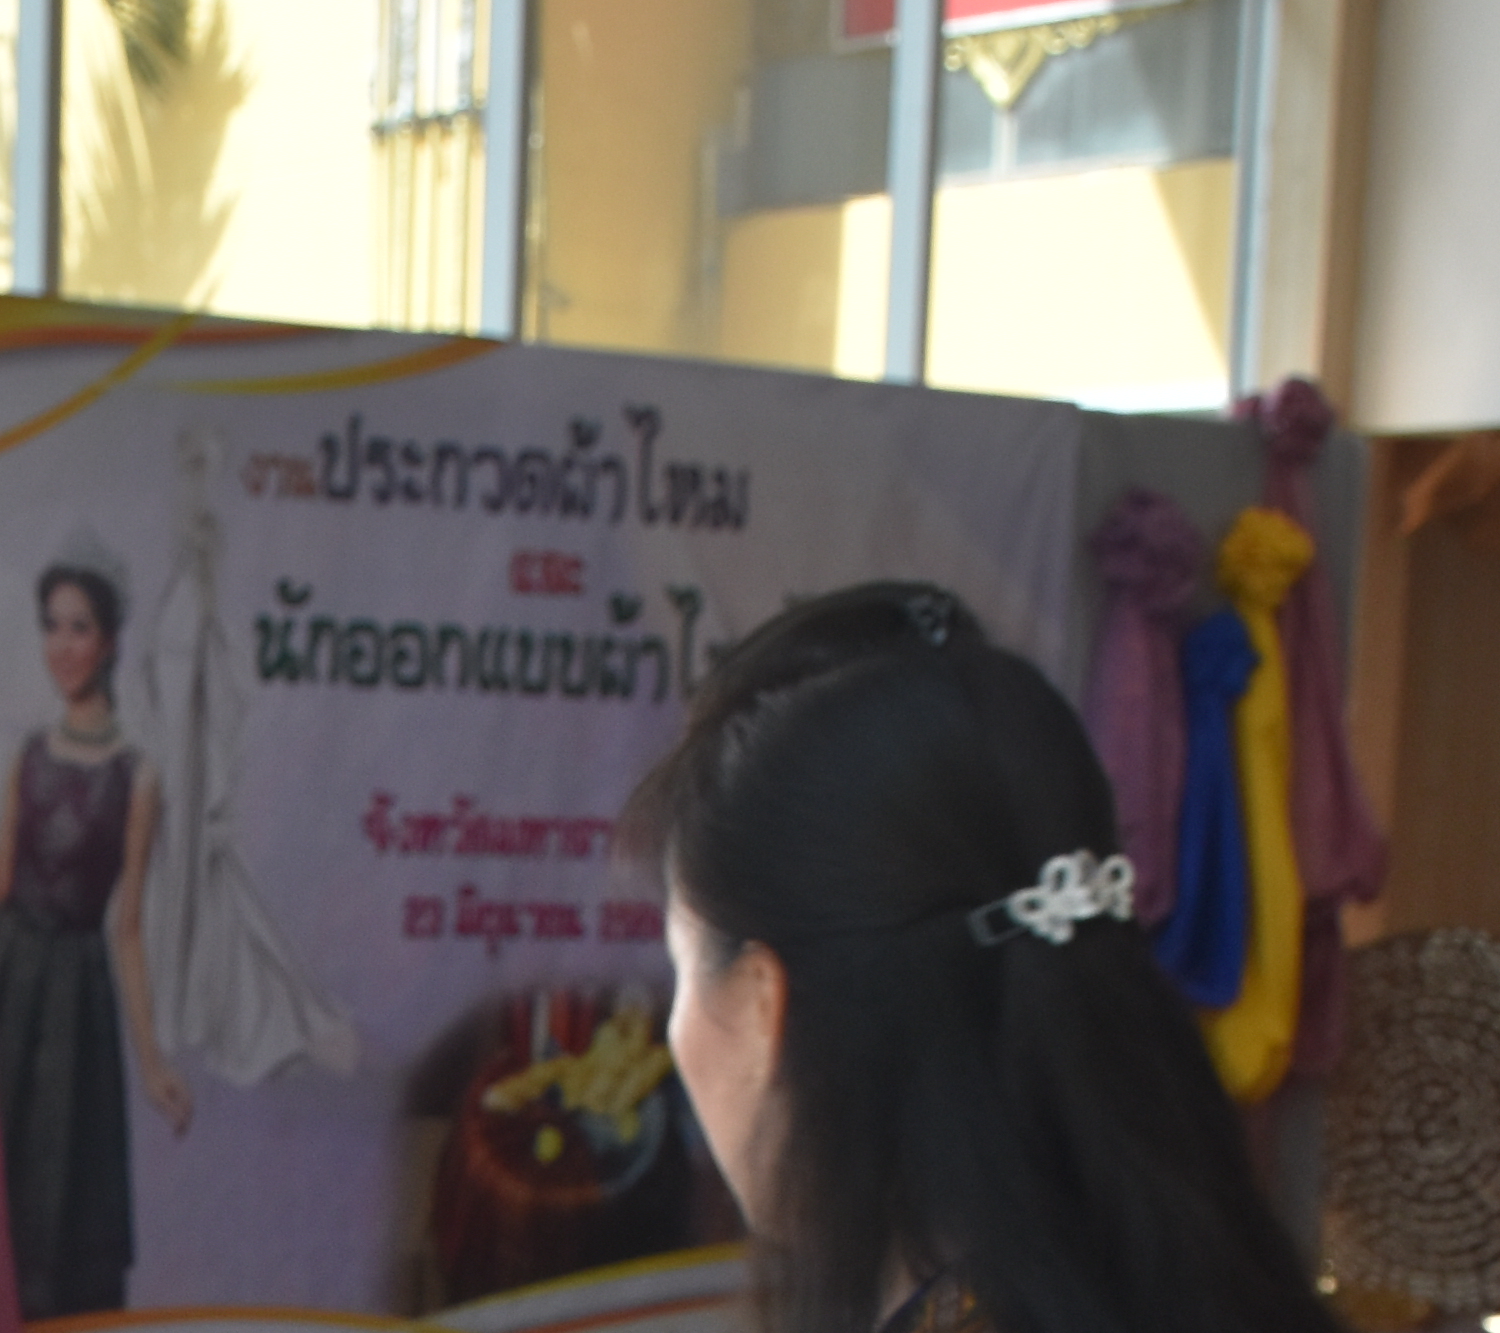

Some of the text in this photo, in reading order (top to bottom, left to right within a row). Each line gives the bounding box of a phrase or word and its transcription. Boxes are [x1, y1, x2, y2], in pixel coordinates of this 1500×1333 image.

[253, 577, 728, 703] นักออกแบบผ้าไ
